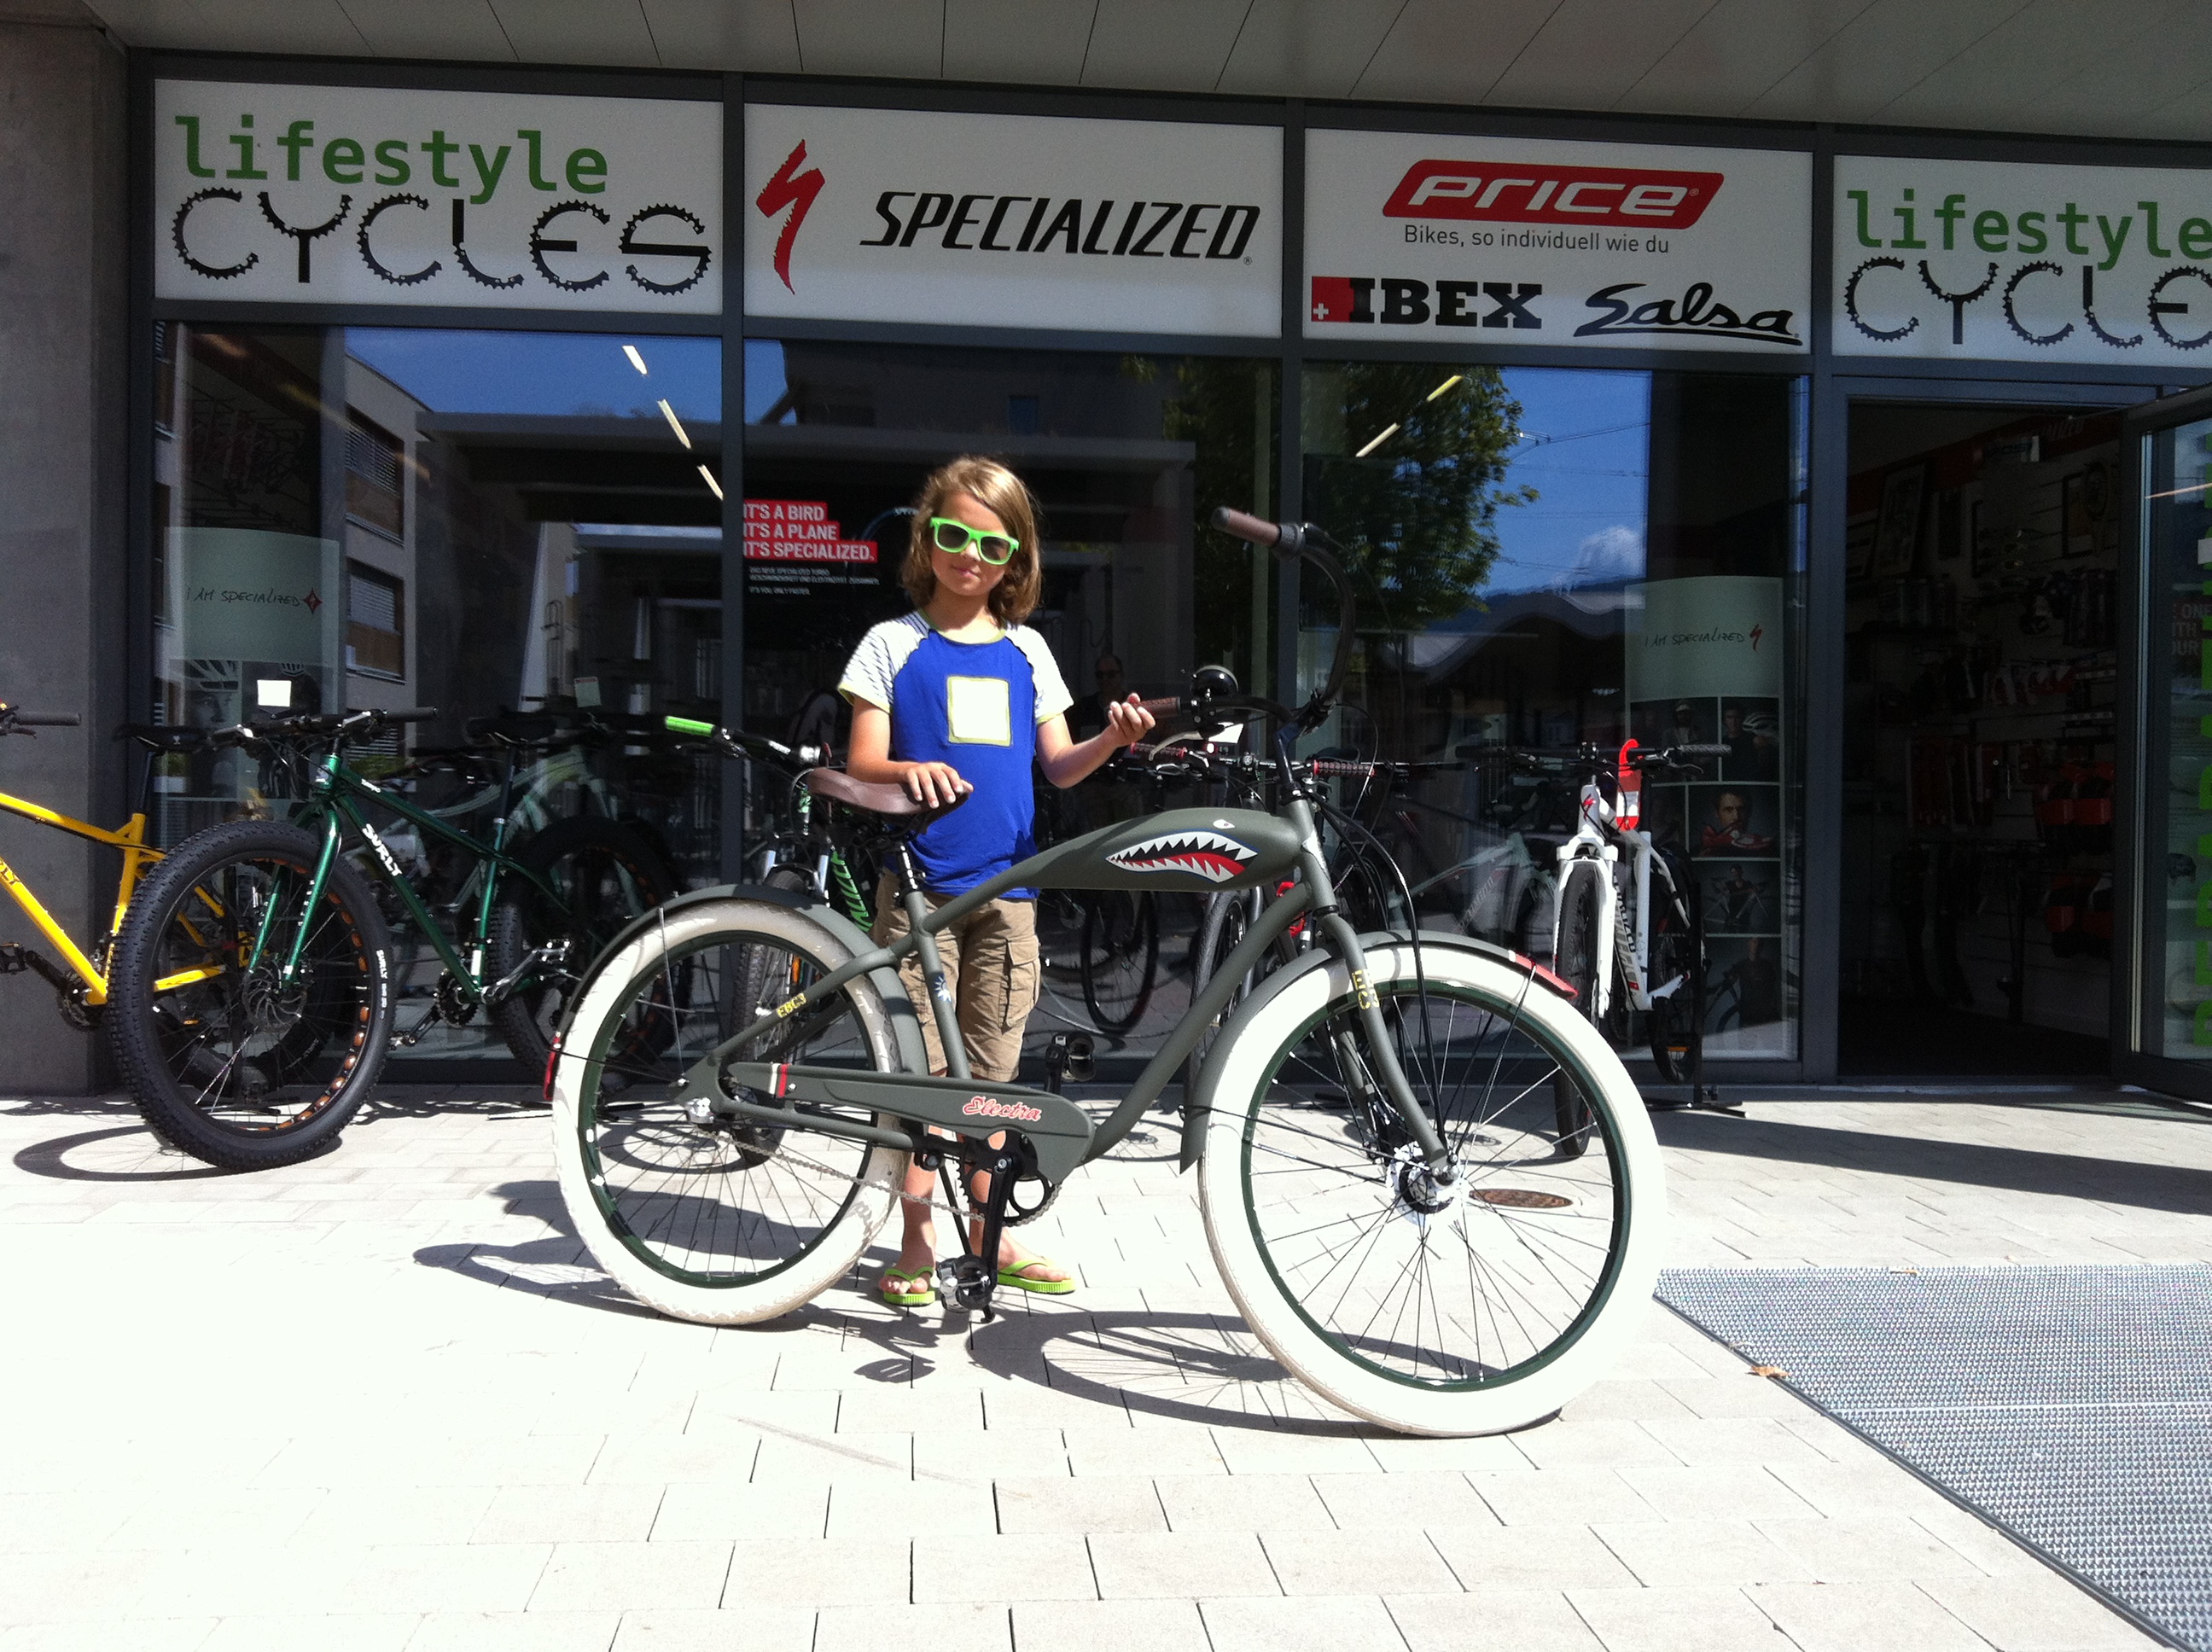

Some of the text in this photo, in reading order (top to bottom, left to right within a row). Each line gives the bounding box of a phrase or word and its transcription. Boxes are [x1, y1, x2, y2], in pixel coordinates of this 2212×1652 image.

[175, 114, 608, 204] lifestyle
[172, 187, 712, 296] CYCLES
[859, 191, 1260, 259] SPECIALIZED
[1405, 224, 1669, 253] Bikes, so individuell wie du
[1847, 188, 2212, 271] lifestyle
[1349, 277, 1542, 329] IBEX
[1573, 282, 1803, 346] Salsa
[743, 503, 824, 521] IT'S A BIRD
[743, 521, 837, 540] IT'S A PLANE
[743, 540, 770, 556] IT'S
[194, 587, 214, 602] AM
[221, 588, 300, 607] SPECIALIZED
[1650, 635, 1666, 647] AM
[1672, 627, 1744, 646] SPECIALIZED
[362, 823, 402, 876] SURLY
[963, 1096, 1042, 1122] Electra
